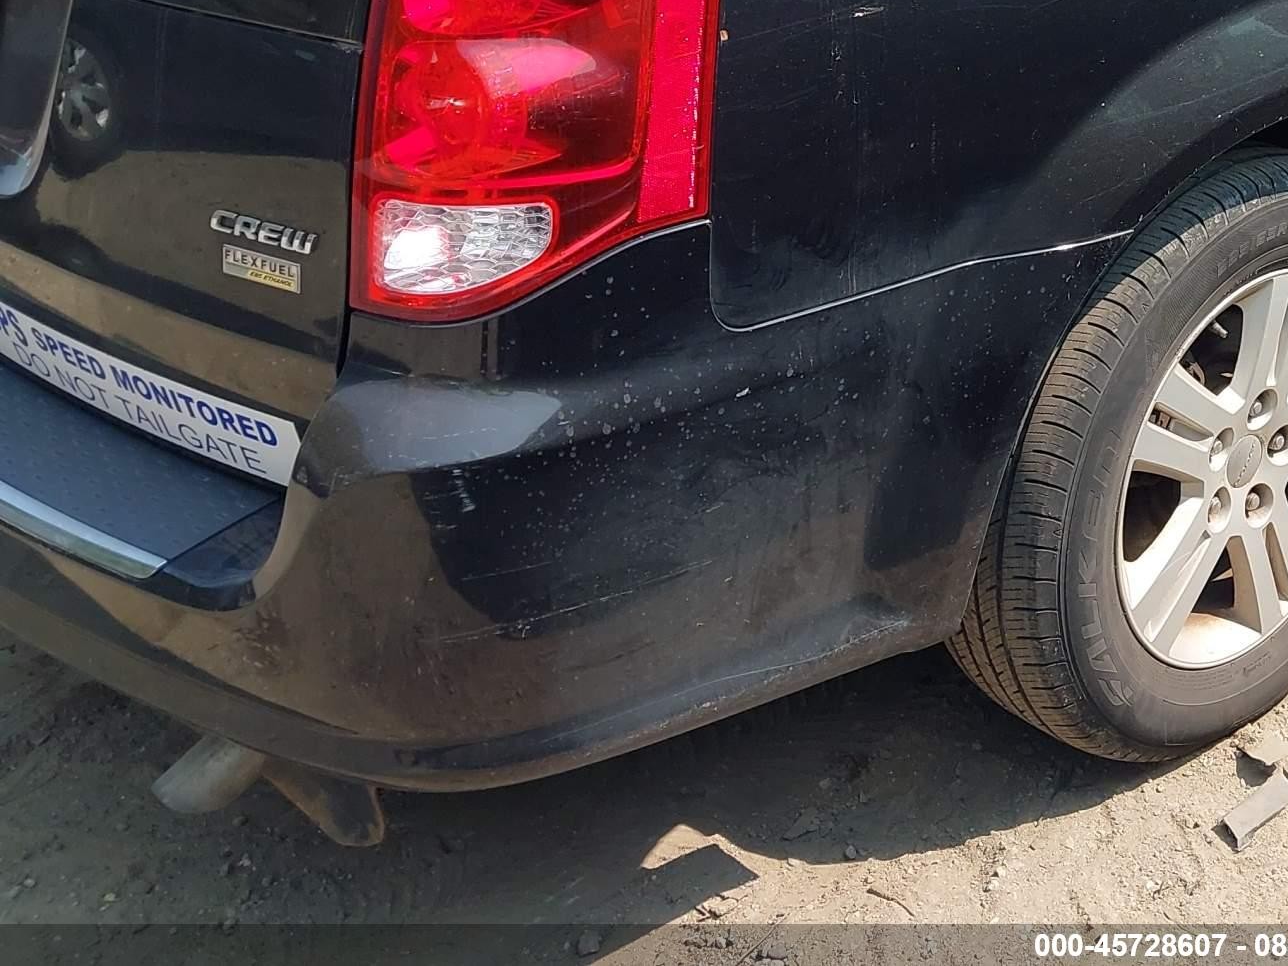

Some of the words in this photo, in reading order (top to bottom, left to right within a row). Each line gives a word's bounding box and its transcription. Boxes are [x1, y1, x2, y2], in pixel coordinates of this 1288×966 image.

[210, 209, 317, 255] CREW
[224, 249, 294, 277] FLEXFUEL
[0, 308, 28, 347] PS
[31, 327, 106, 380] SPEED
[110, 365, 277, 446] MONITORED
[12, 341, 50, 377] DO
[54, 365, 109, 408] NOT
[114, 395, 266, 474] TAILGATE
